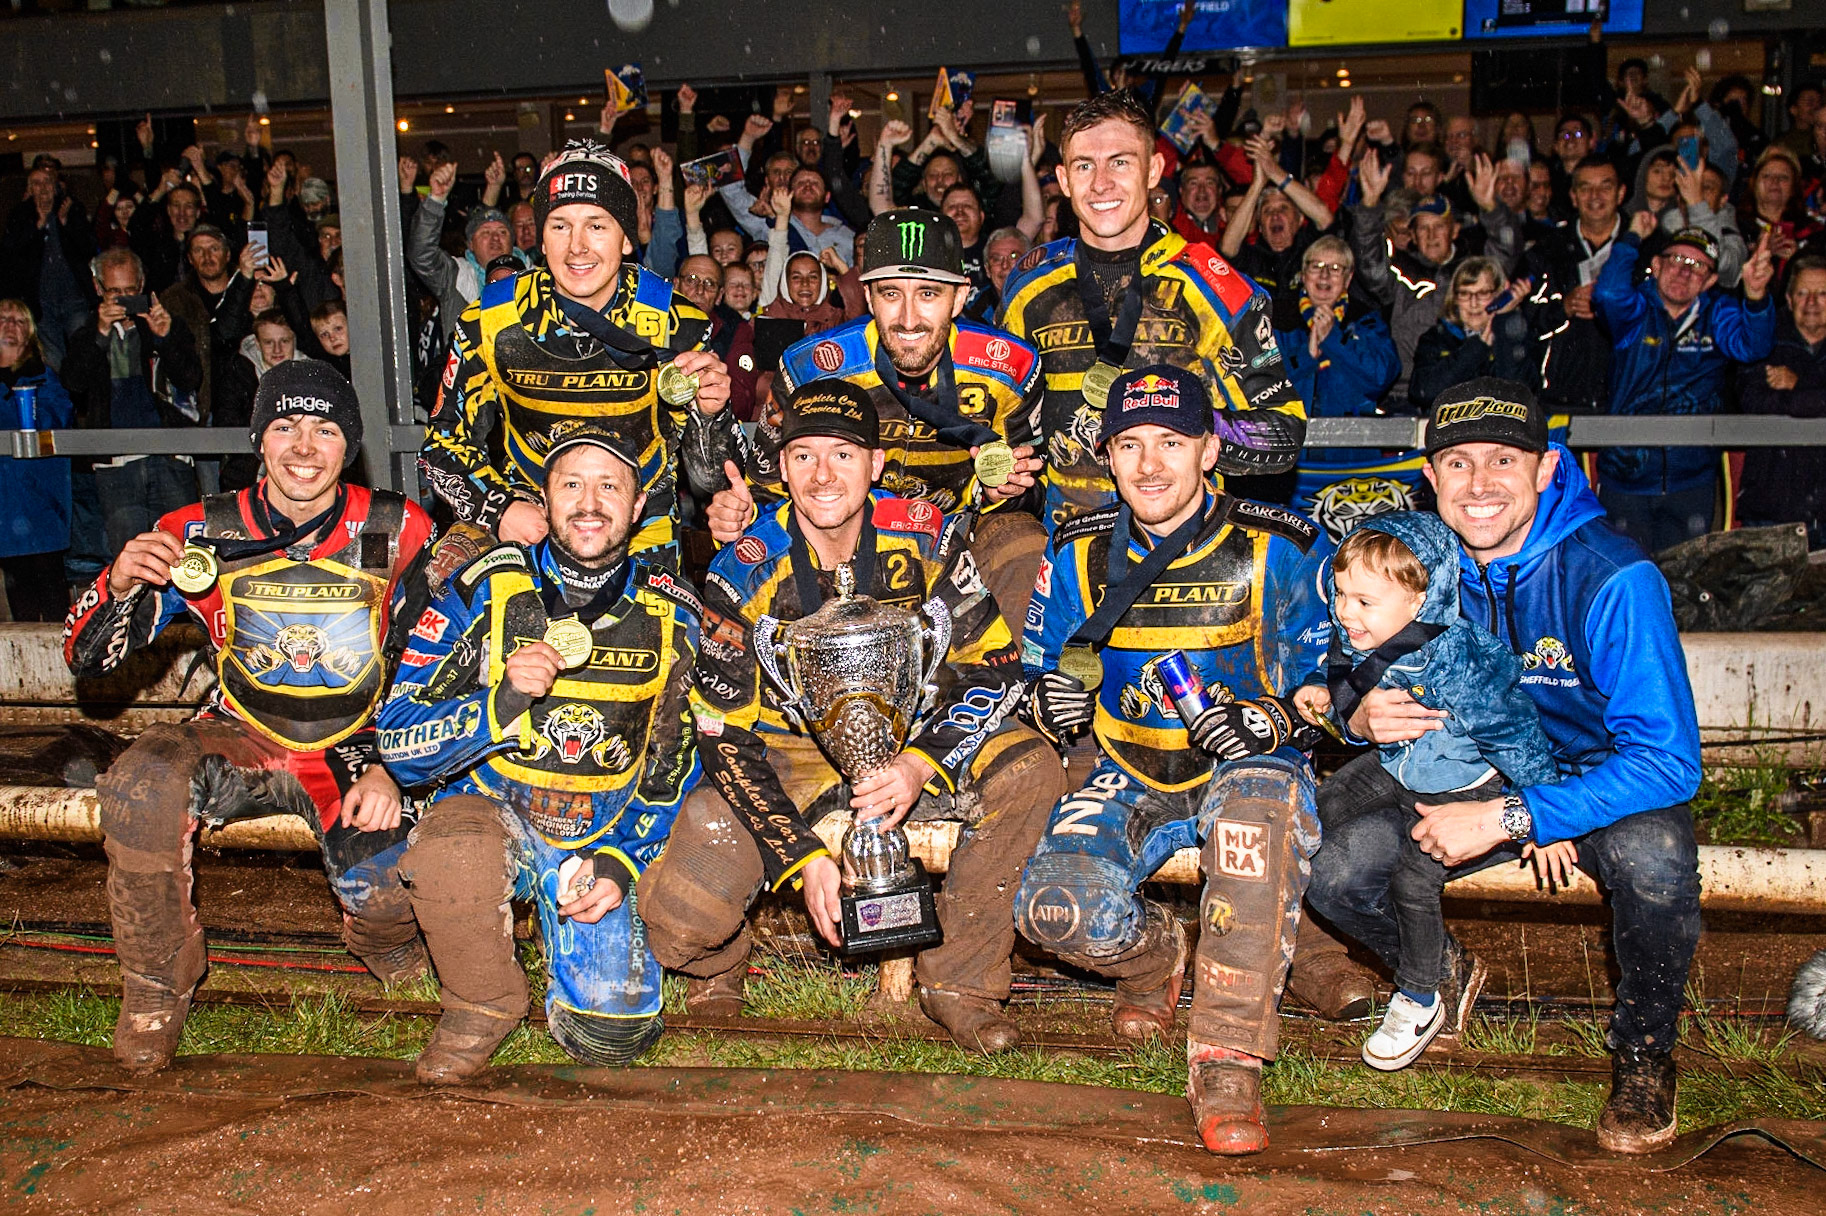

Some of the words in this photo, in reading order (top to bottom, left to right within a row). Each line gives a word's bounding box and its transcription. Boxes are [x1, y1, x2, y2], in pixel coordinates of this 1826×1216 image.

[563, 174, 598, 192] FTS
[635, 311, 661, 337] 6
[1037, 323, 1085, 347] TRU
[968, 356, 991, 368] ERIC
[991, 359, 1018, 377] STEAD
[514, 371, 549, 385] TRU
[562, 373, 640, 388] PLANT
[799, 405, 842, 416] Services
[838, 395, 858, 409] Car
[958, 387, 986, 415] 3
[1122, 396, 1151, 411] Red
[1153, 394, 1179, 409] Bull
[476, 490, 507, 529] FTS
[1239, 502, 1314, 535] GARCAREK
[890, 520, 911, 530] ERIC
[887, 553, 910, 590] 2
[254, 584, 289, 596] TRU
[289, 585, 355, 598] PLANT
[1154, 585, 1234, 602] PLANT
[645, 593, 669, 617] 5
[592, 652, 648, 668] LANT
[1519, 675, 1559, 686] SHEFFIELD
[1560, 677, 1581, 688] TIGE
[425, 744, 439, 753] LTD
[717, 742, 770, 812] Complete
[768, 814, 798, 844] Car
[763, 836, 794, 866] Ltd
[1225, 850, 1256, 873] RA
